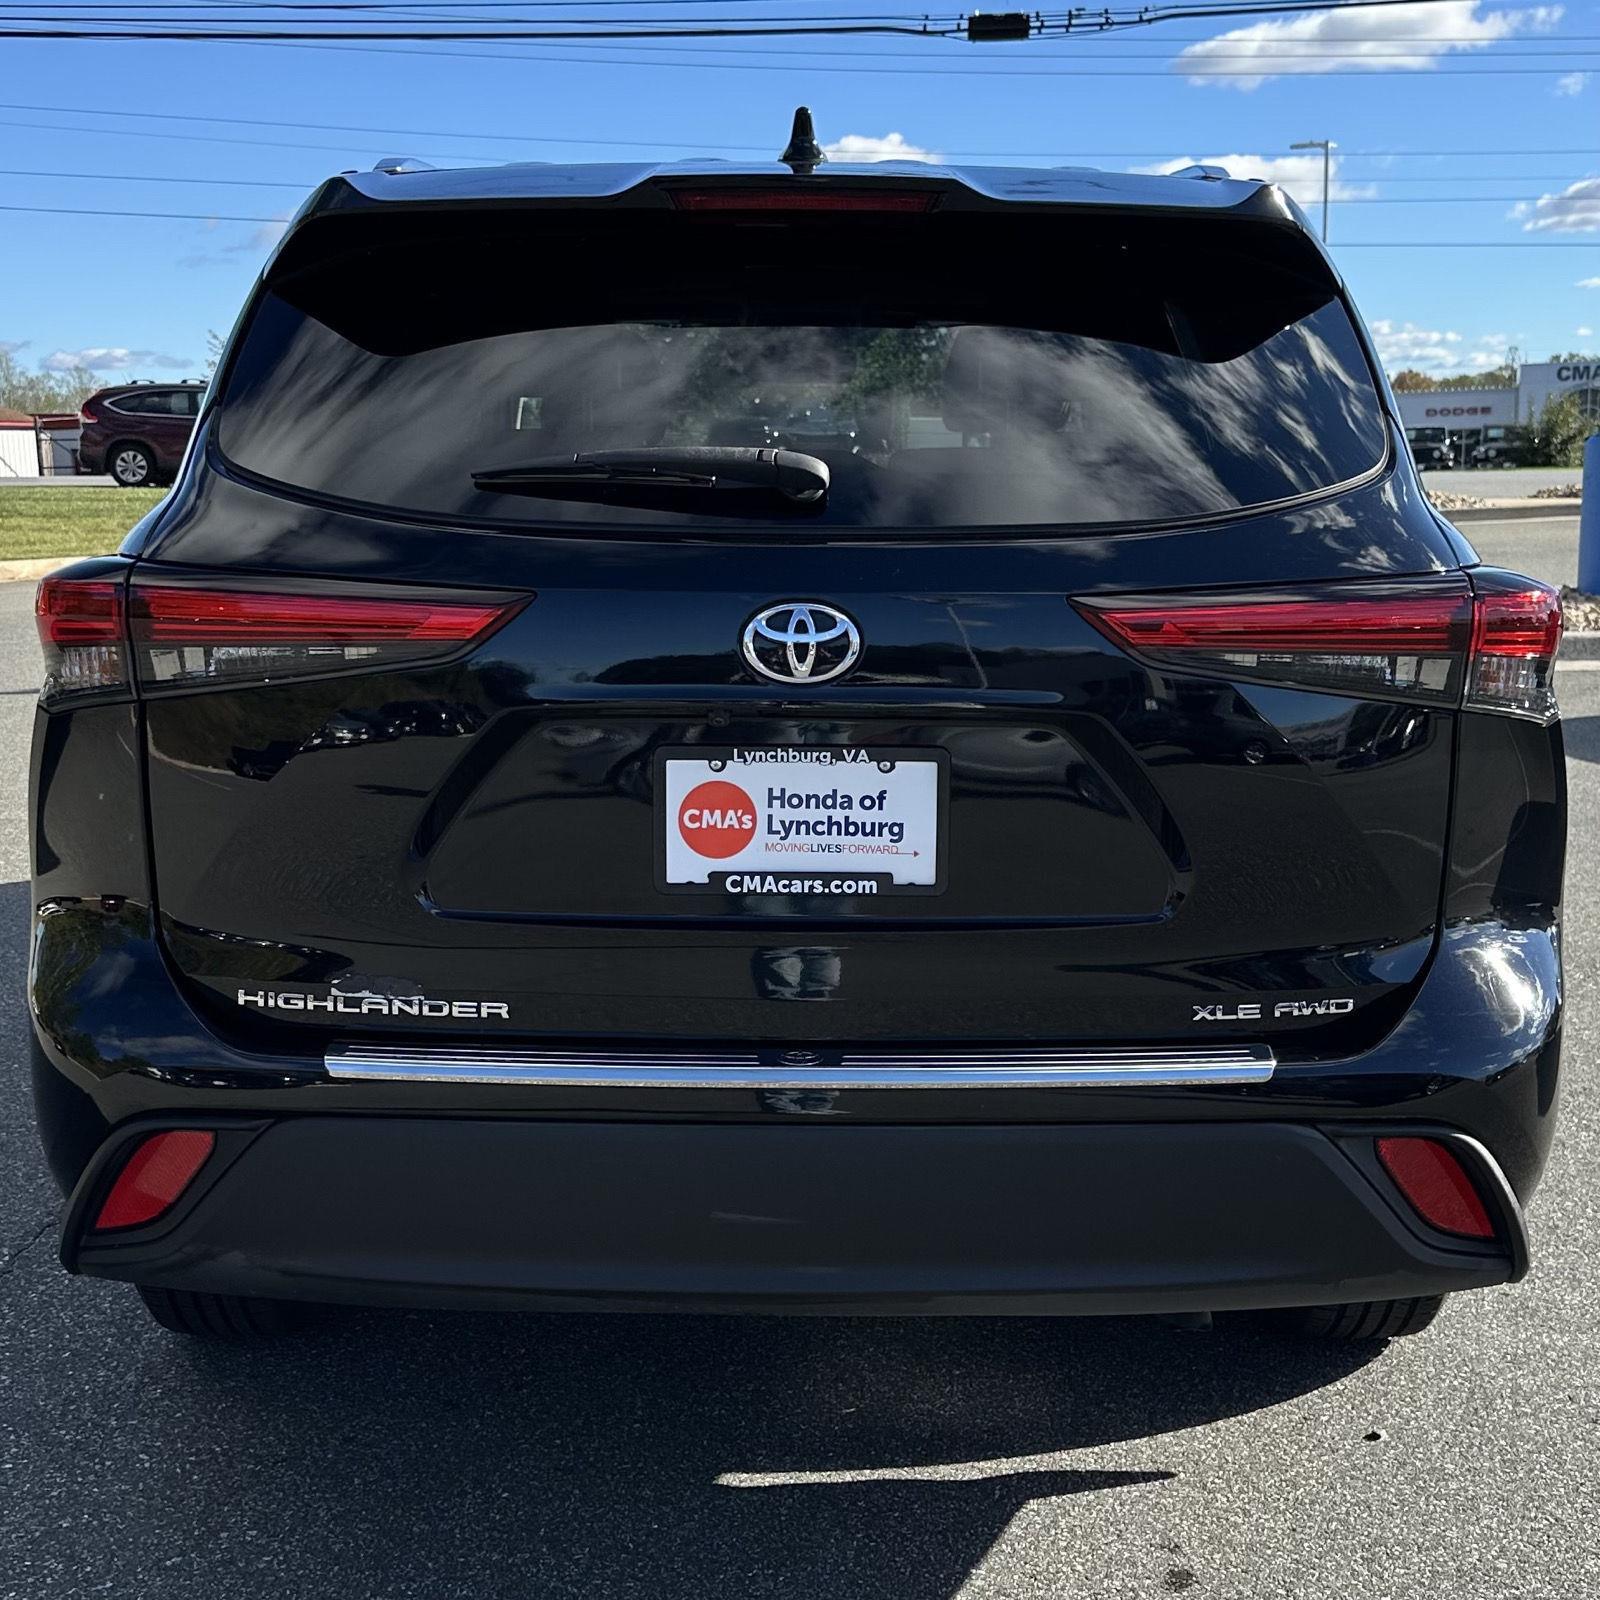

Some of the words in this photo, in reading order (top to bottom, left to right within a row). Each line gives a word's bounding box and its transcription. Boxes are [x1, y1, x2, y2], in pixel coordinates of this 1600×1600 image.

[1425, 406, 1492, 417] DODGE
[733, 748, 836, 765] Lynchburg,
[842, 749, 870, 763] VA
[767, 787, 853, 810] Honda
[858, 789, 888, 811] of
[682, 808, 753, 829] CMA's
[767, 814, 904, 843] Lynchburg
[725, 875, 878, 894] CMAcars.com
[237, 989, 510, 1019] HIGHLANDER
[1192, 1004, 1262, 1021] XLE
[1274, 998, 1354, 1018] AWD
